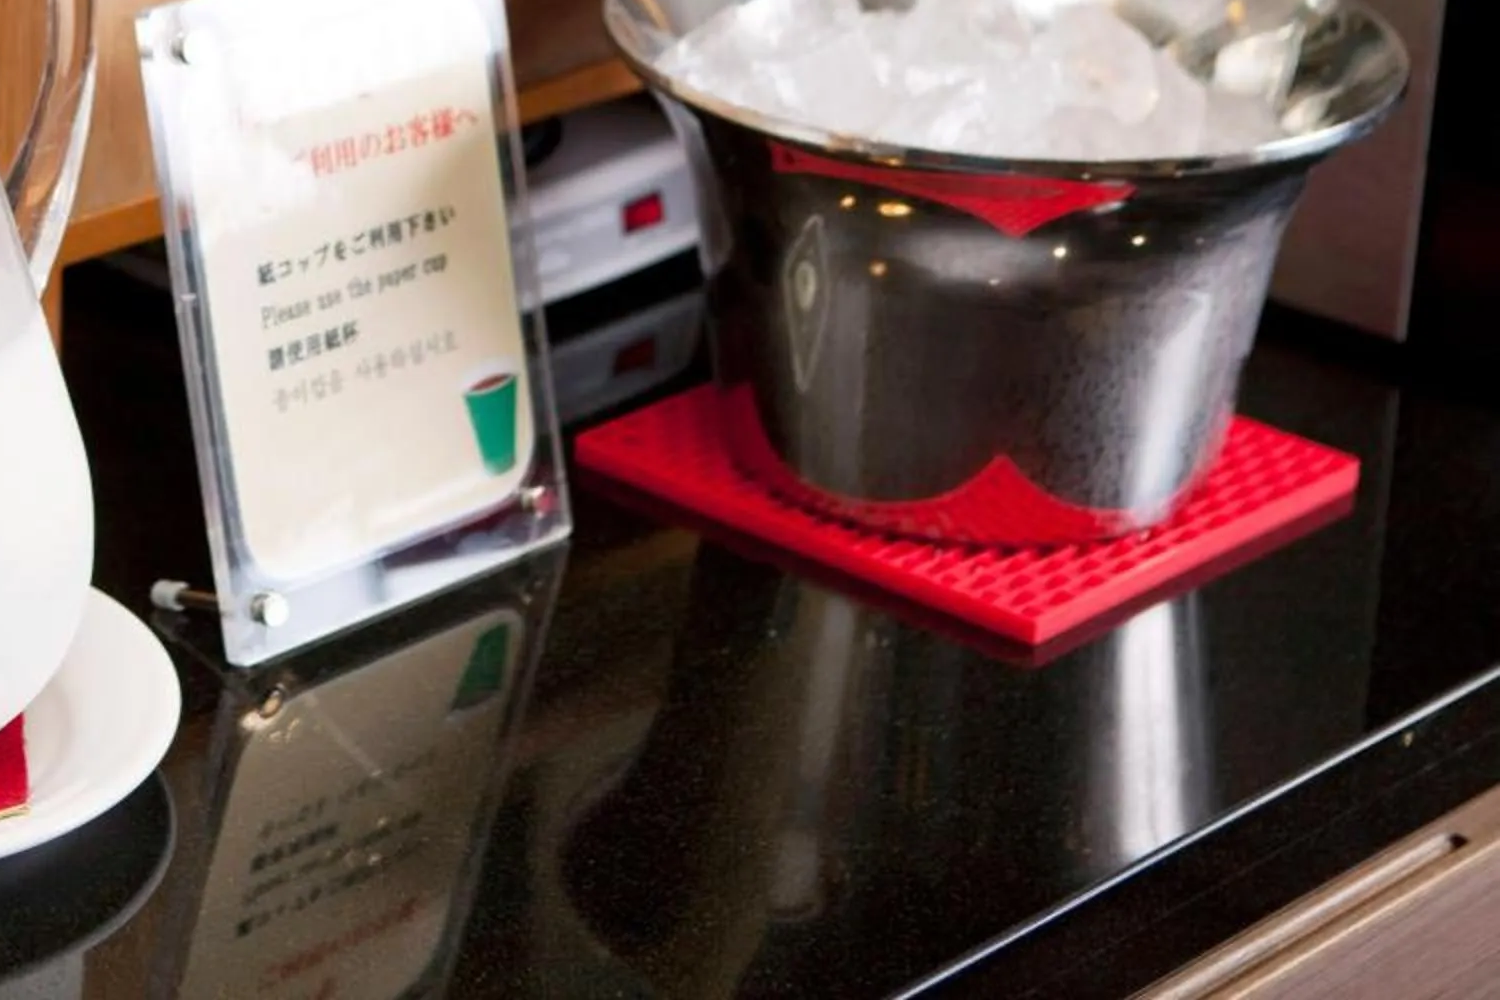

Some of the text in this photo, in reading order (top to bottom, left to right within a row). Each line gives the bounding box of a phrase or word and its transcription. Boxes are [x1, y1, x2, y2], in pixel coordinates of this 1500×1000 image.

[261, 253, 448, 330] Please use the paper cup
